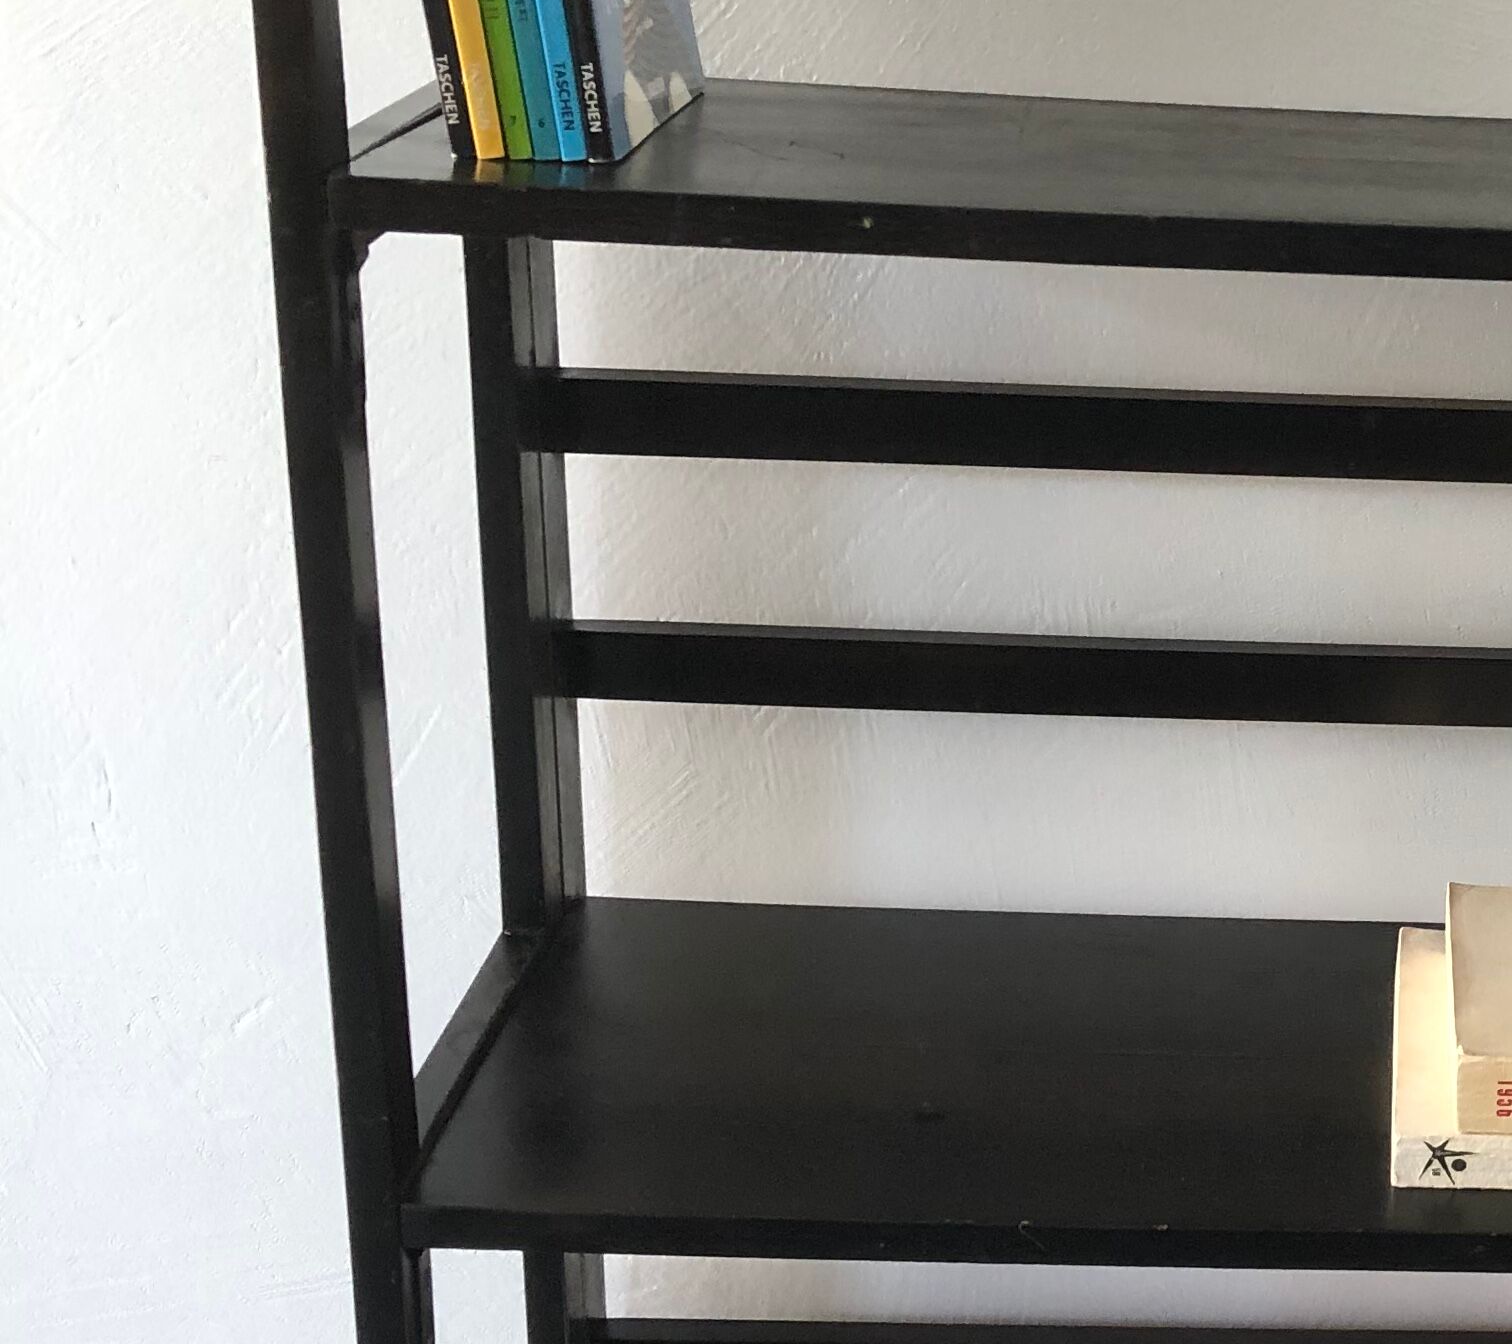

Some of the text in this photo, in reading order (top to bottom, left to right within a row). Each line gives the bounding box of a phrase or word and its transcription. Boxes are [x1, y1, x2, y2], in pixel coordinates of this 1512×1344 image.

[435, 54, 460, 125] TASCHEN
[553, 62, 575, 131] TASCHEN
[580, 63, 603, 134] TASCHEN
